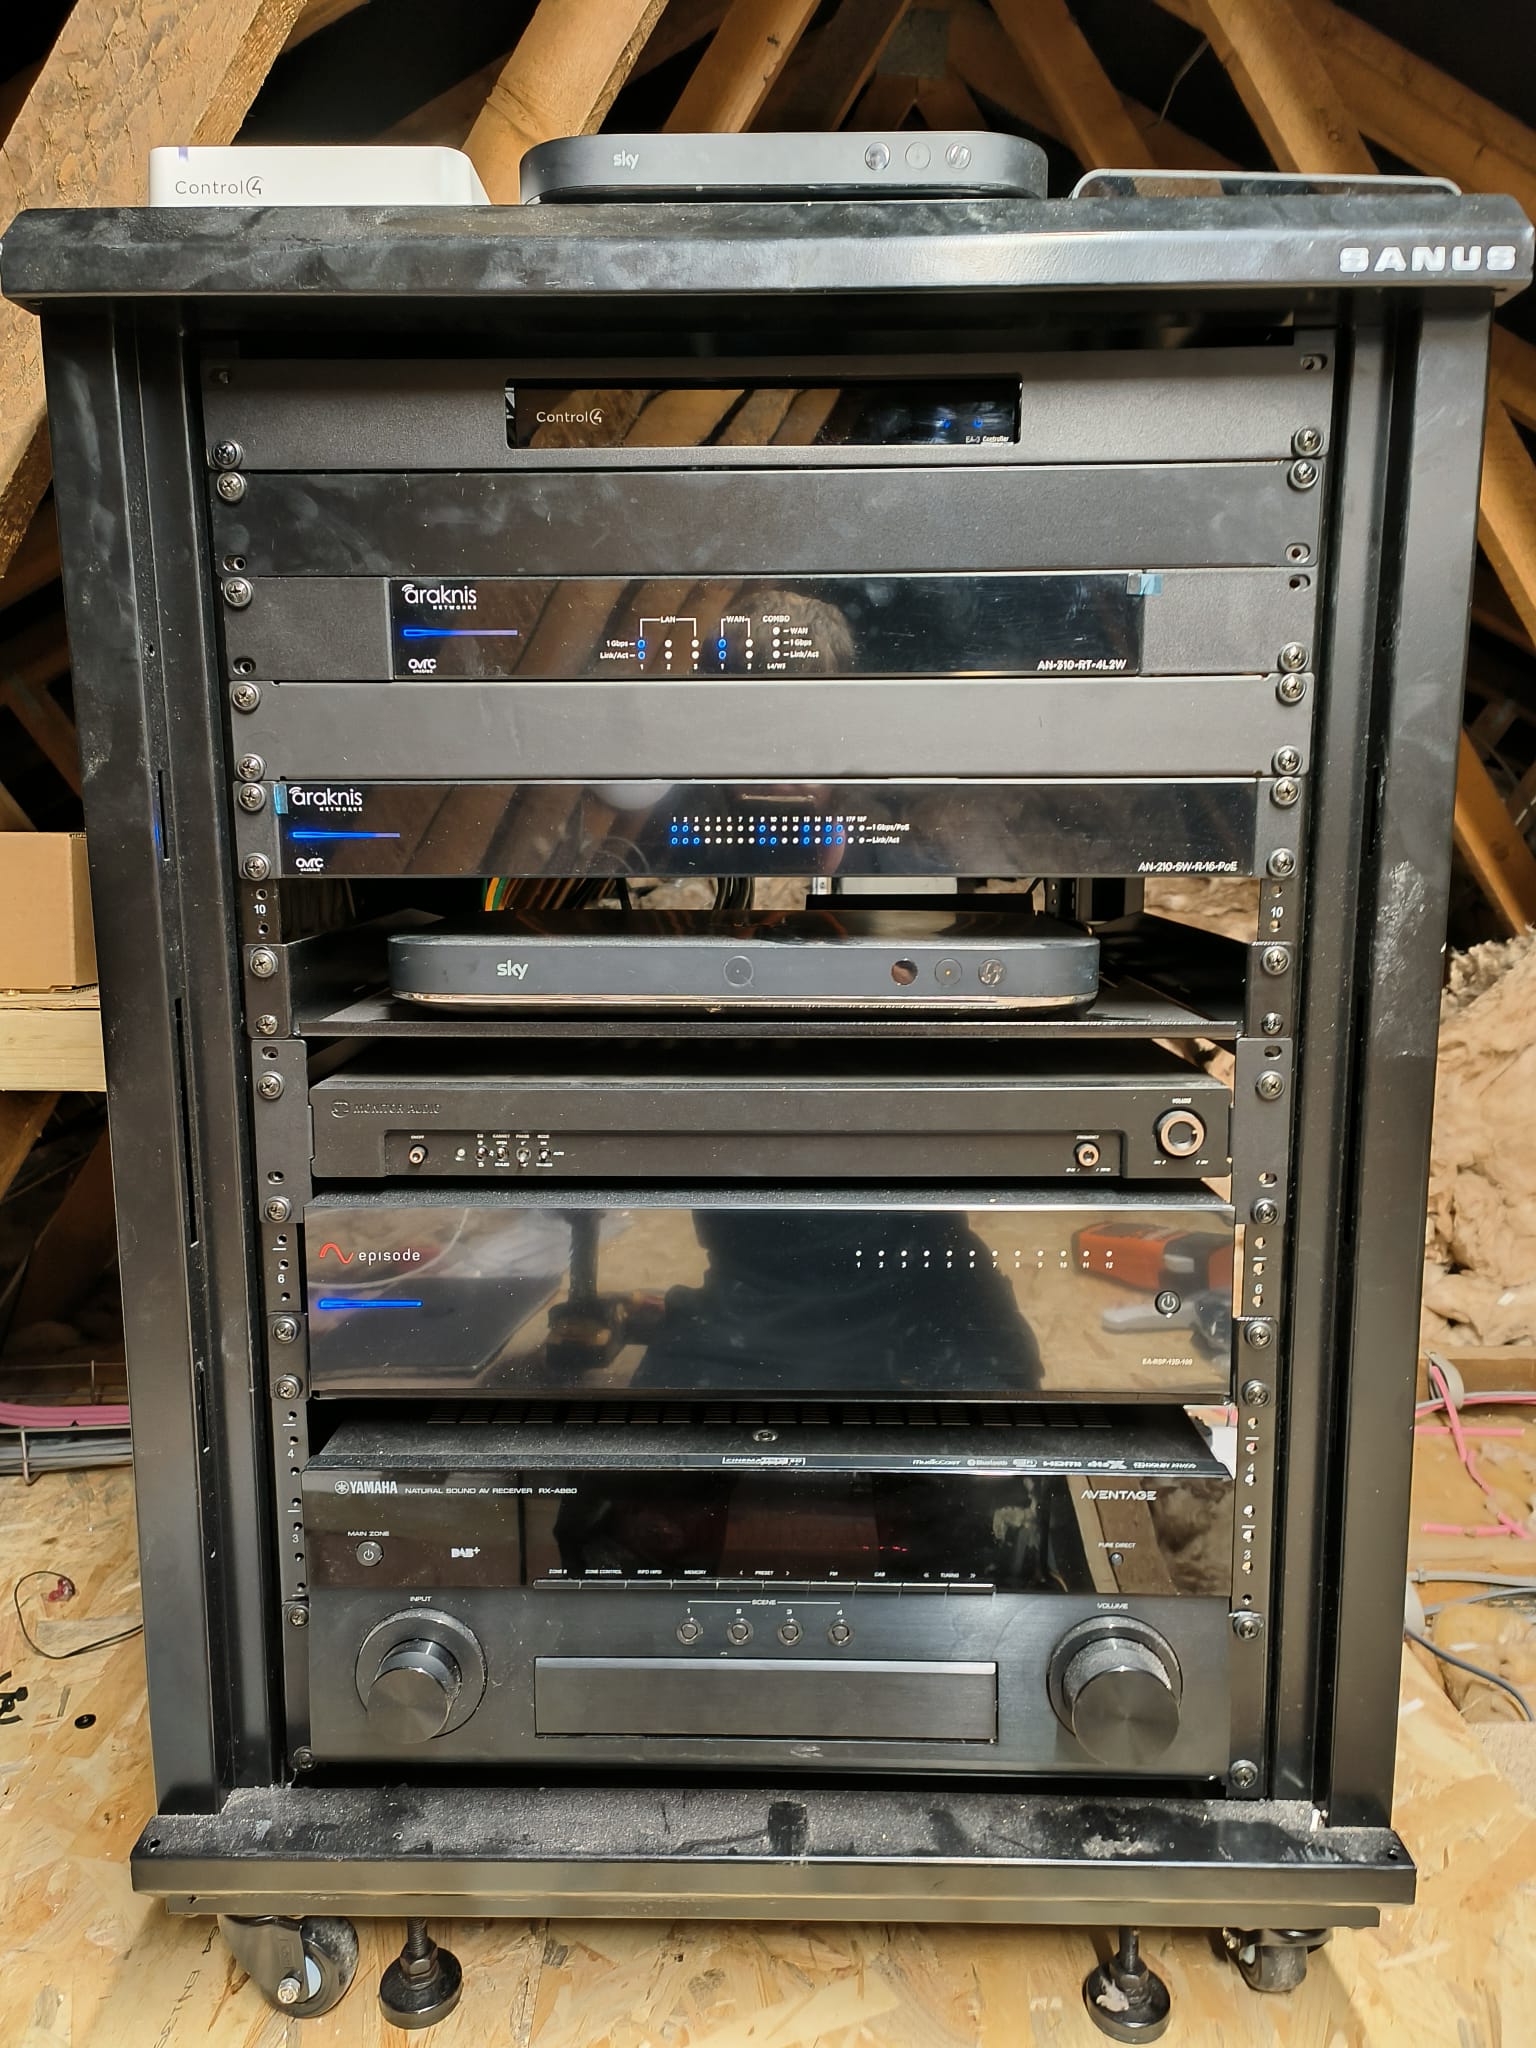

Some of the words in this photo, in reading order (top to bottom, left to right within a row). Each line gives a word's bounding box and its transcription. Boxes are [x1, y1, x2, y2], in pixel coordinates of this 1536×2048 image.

[614, 150, 639, 170] sky
[175, 176, 263, 198] Control4
[1340, 246, 1516, 272] SANUS
[536, 408, 605, 425] Control4
[402, 584, 477, 604] araknis
[795, 639, 812, 647] Gbps
[1037, 659, 1127, 670] AN-310-RT-4L2W
[289, 787, 363, 805] araknis
[254, 904, 266, 914] 10
[1271, 907, 1283, 917] 10
[497, 960, 529, 980] sky
[359, 1248, 421, 1266] episode
[278, 1274, 285, 1283] 6
[1255, 1284, 1263, 1293] 6
[288, 1450, 294, 1458] 4
[1247, 1463, 1254, 1471] 4
[350, 1481, 398, 1494] YAMAHA
[1081, 1490, 1157, 1500] AVENTAGE
[292, 1534, 299, 1543] 3
[1244, 1550, 1251, 1559] 3
